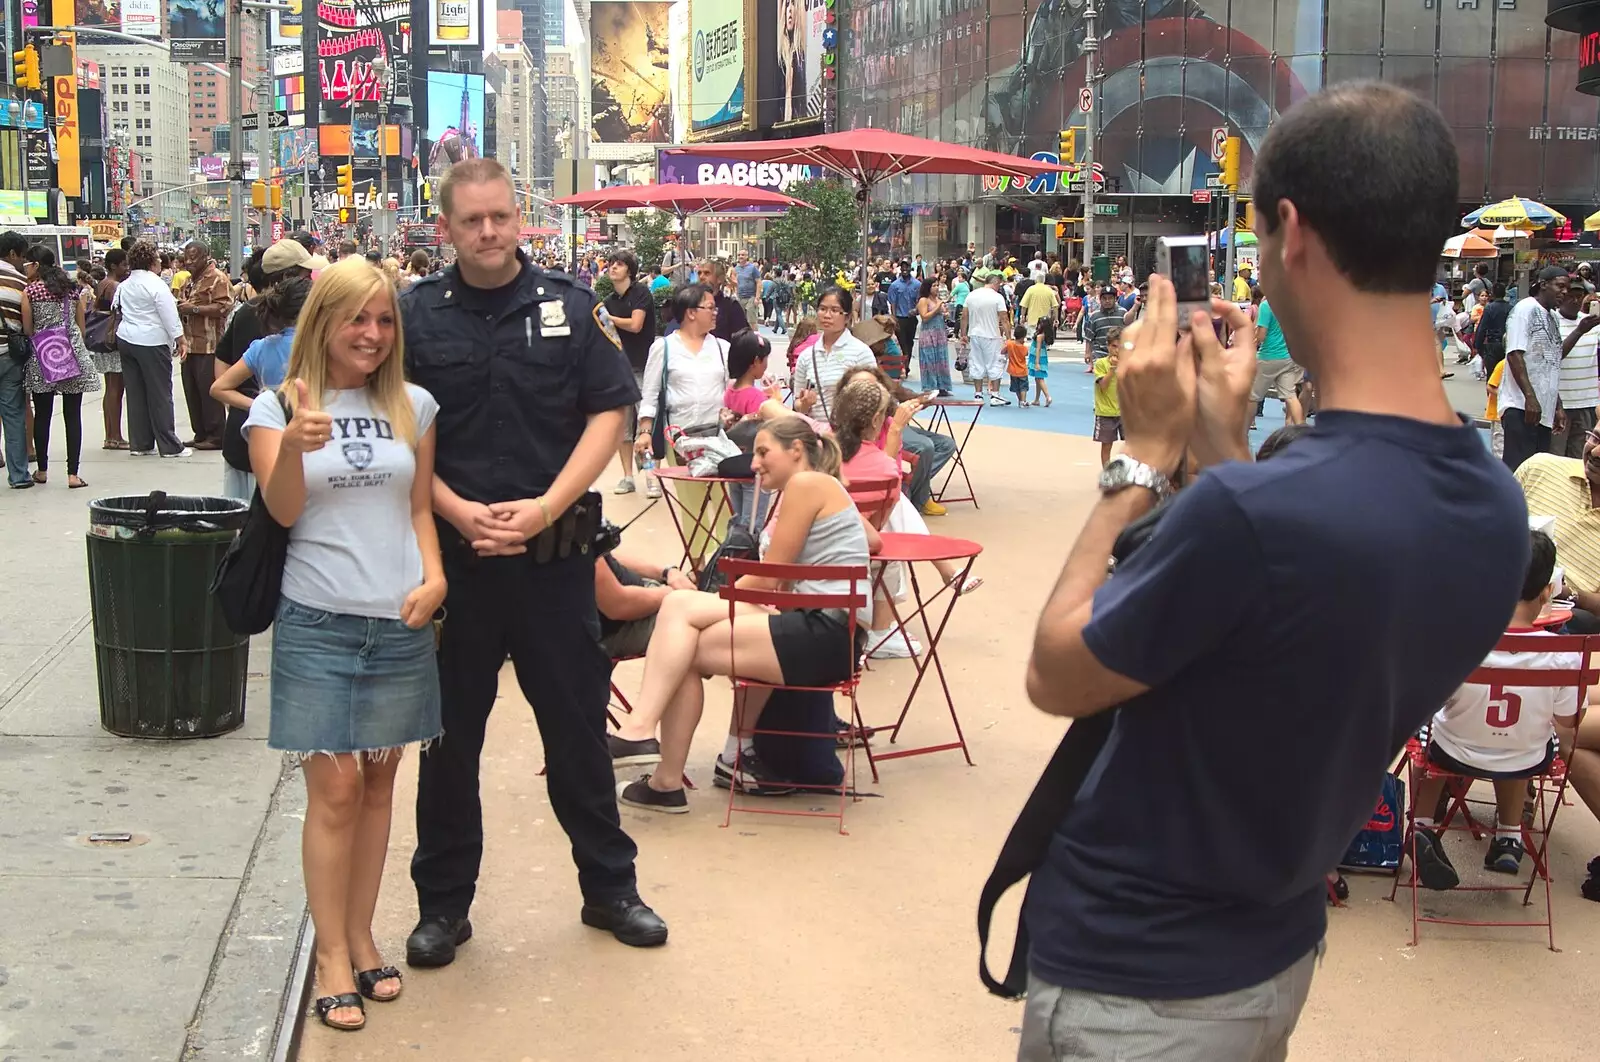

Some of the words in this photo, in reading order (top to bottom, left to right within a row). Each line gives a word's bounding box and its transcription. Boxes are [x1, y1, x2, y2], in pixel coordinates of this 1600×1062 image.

[440, 2, 466, 16] Light
[920, 21, 982, 50] AVENGER
[1556, 127, 1600, 140] THEA
[331, 417, 394, 440] YPD
[1485, 684, 1522, 728] 5
